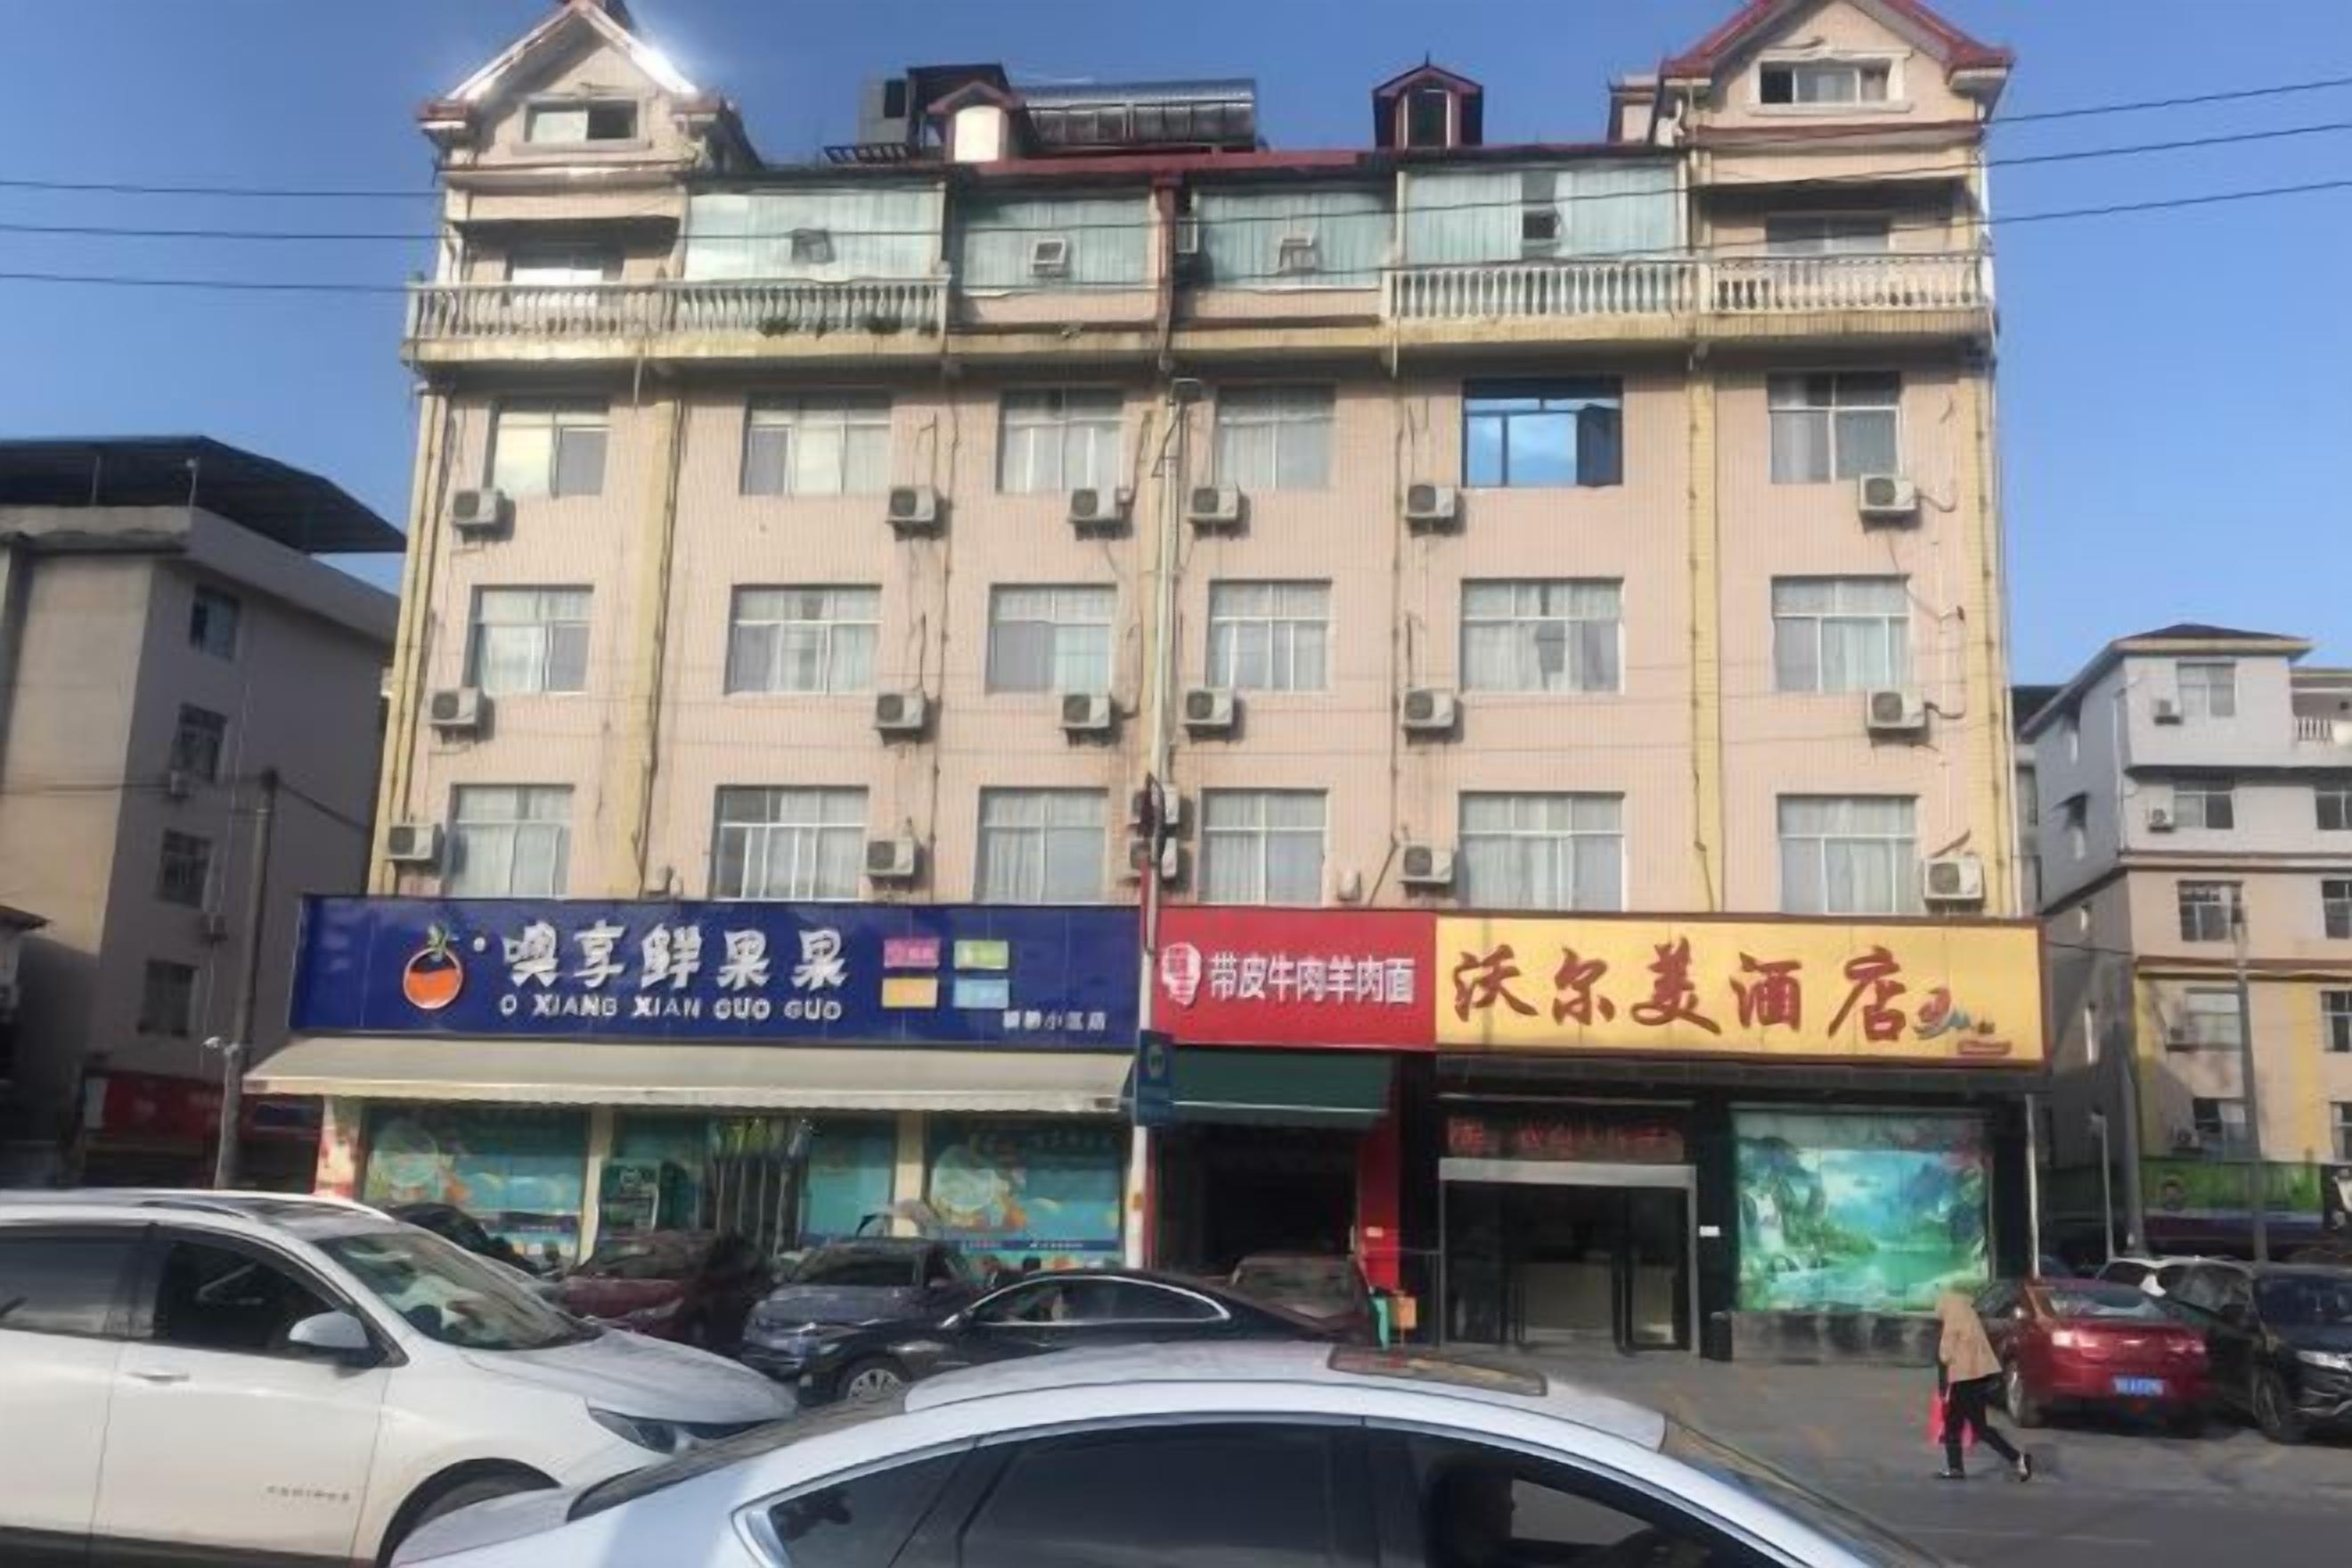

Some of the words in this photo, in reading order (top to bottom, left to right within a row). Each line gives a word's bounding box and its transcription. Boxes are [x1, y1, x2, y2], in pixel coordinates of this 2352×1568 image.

[1209, 950, 1414, 1004] 带皮牛肉羊肉面
[1451, 936, 1907, 1042] 沃尔美酒店
[501, 994, 517, 1016] O
[533, 993, 617, 1017] XIANG
[630, 997, 701, 1017] XIAN
[713, 997, 772, 1019] GUO
[784, 999, 843, 1020] GUO
